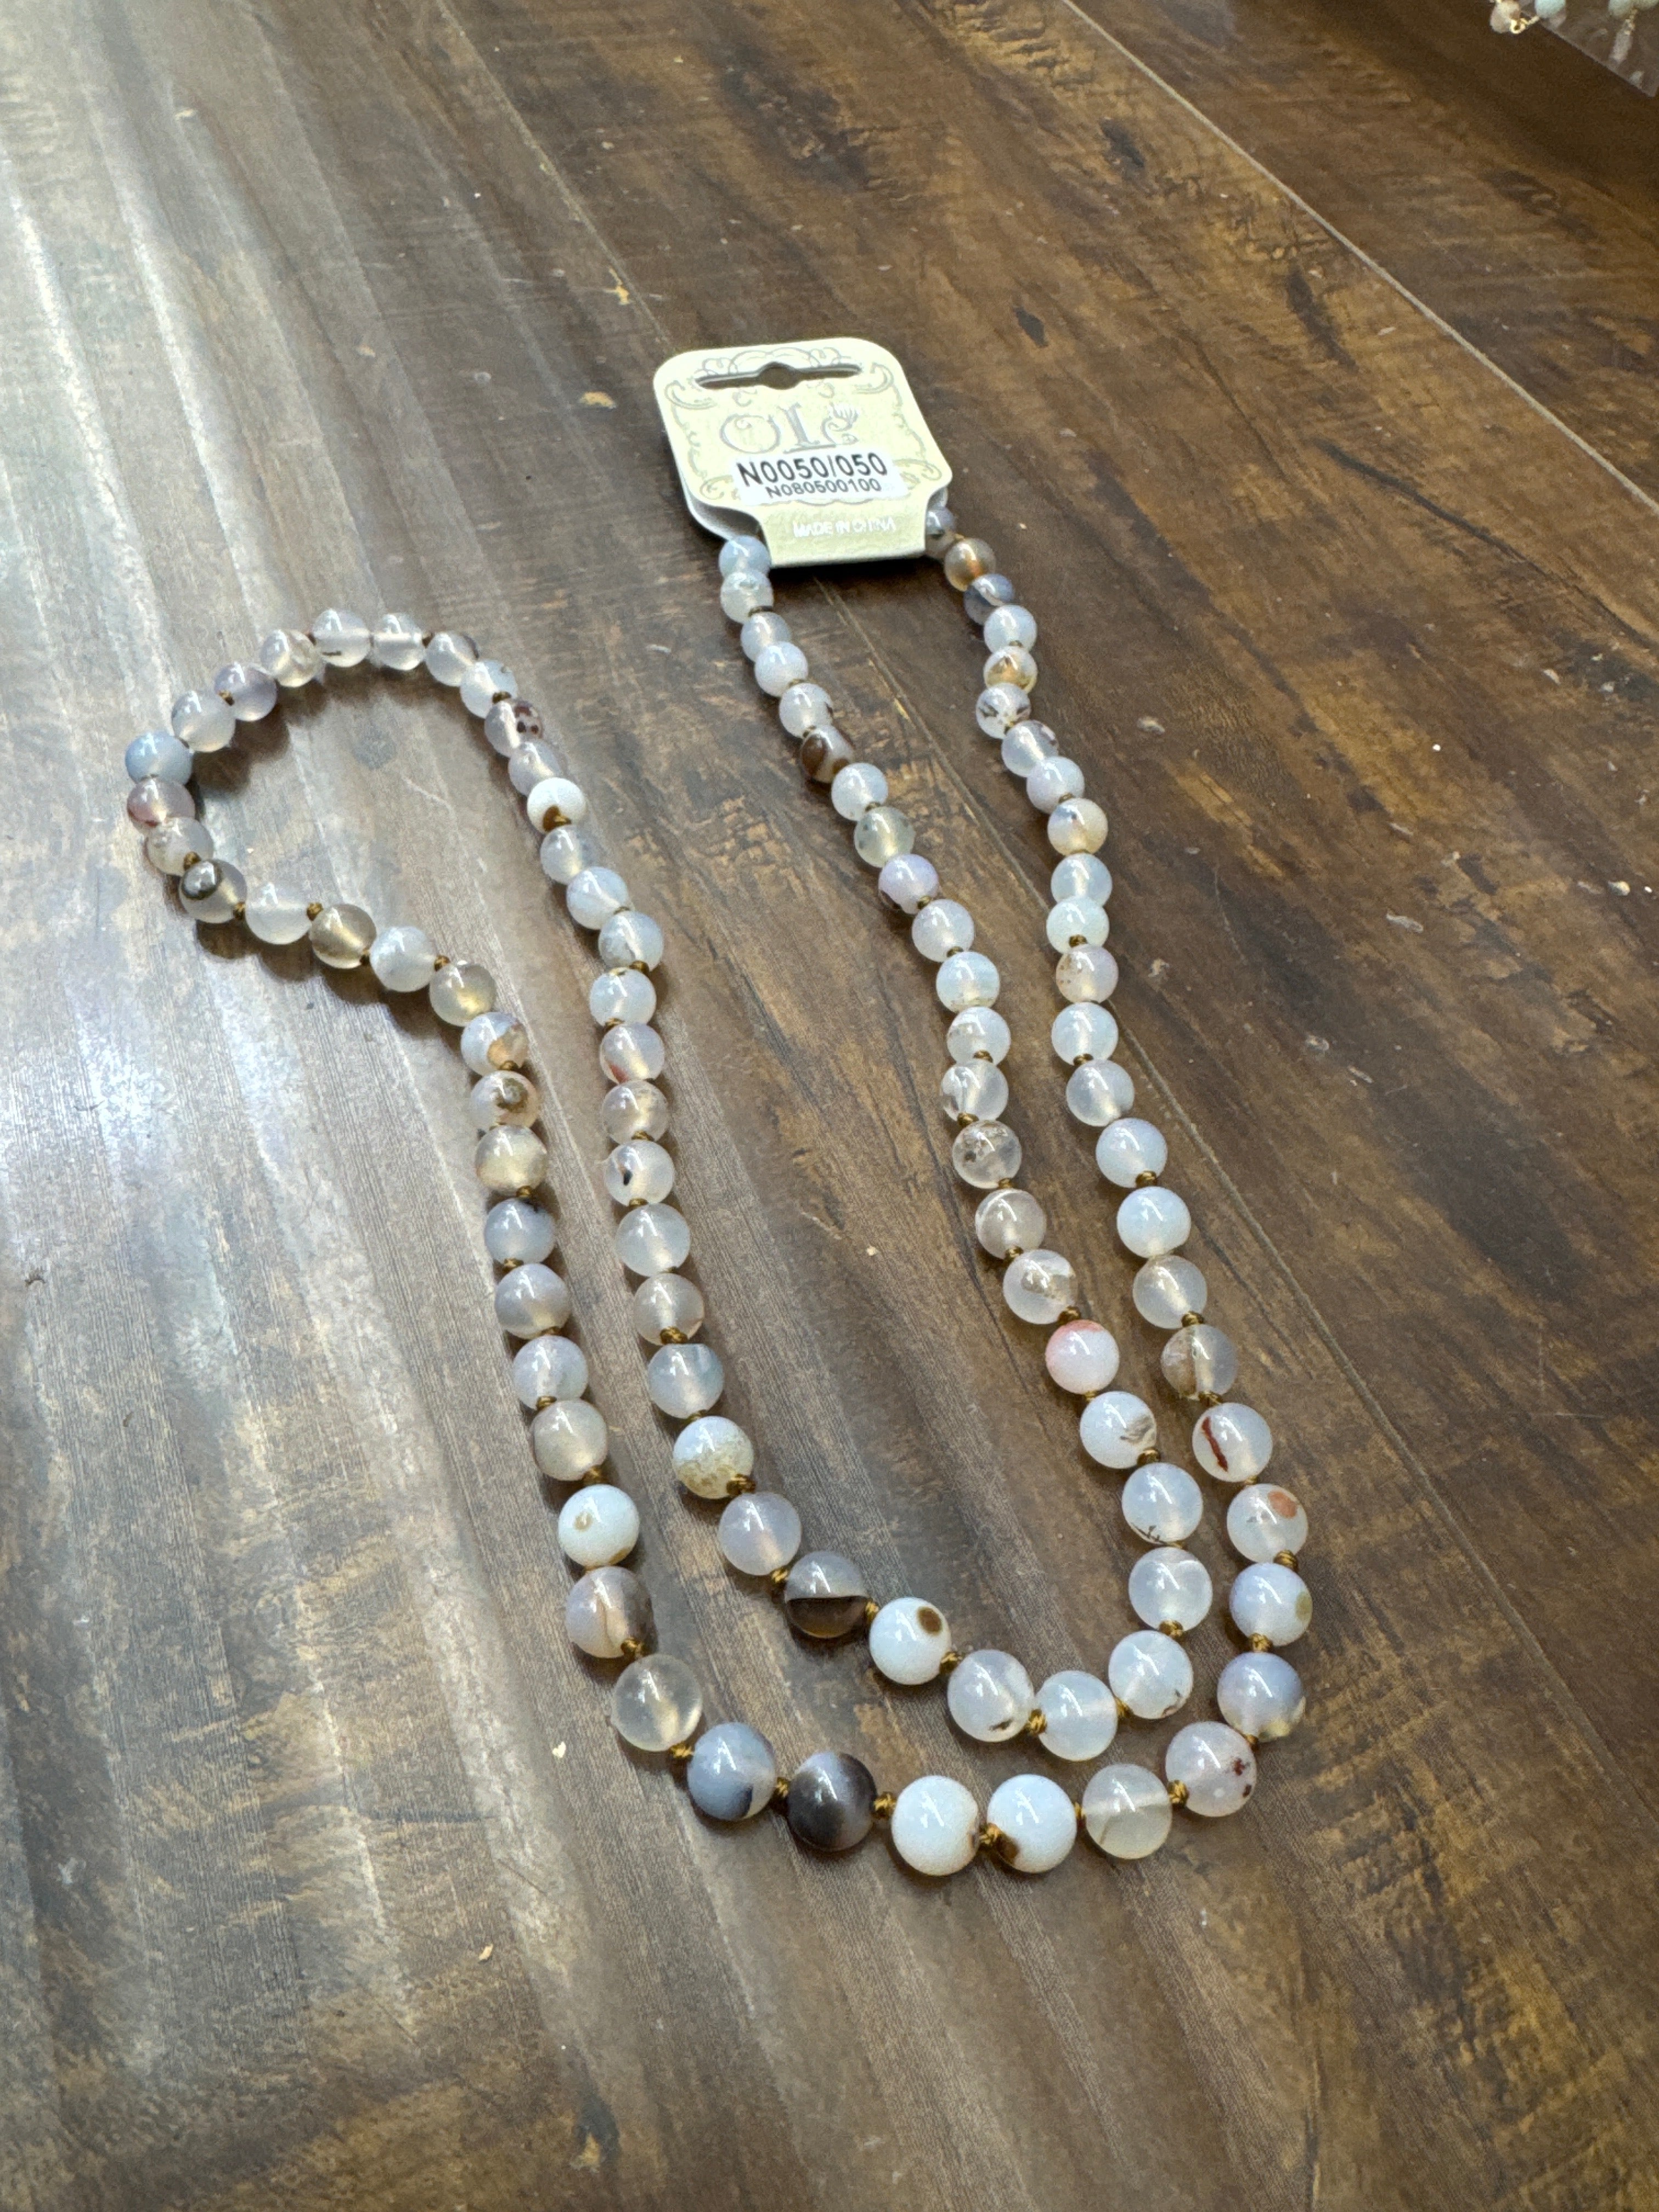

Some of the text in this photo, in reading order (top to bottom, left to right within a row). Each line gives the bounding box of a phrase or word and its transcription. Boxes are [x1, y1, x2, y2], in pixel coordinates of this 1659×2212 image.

[737, 453, 887, 487] N0050/050
[793, 521, 833, 537] MADE
[836, 520, 850, 534] IN
